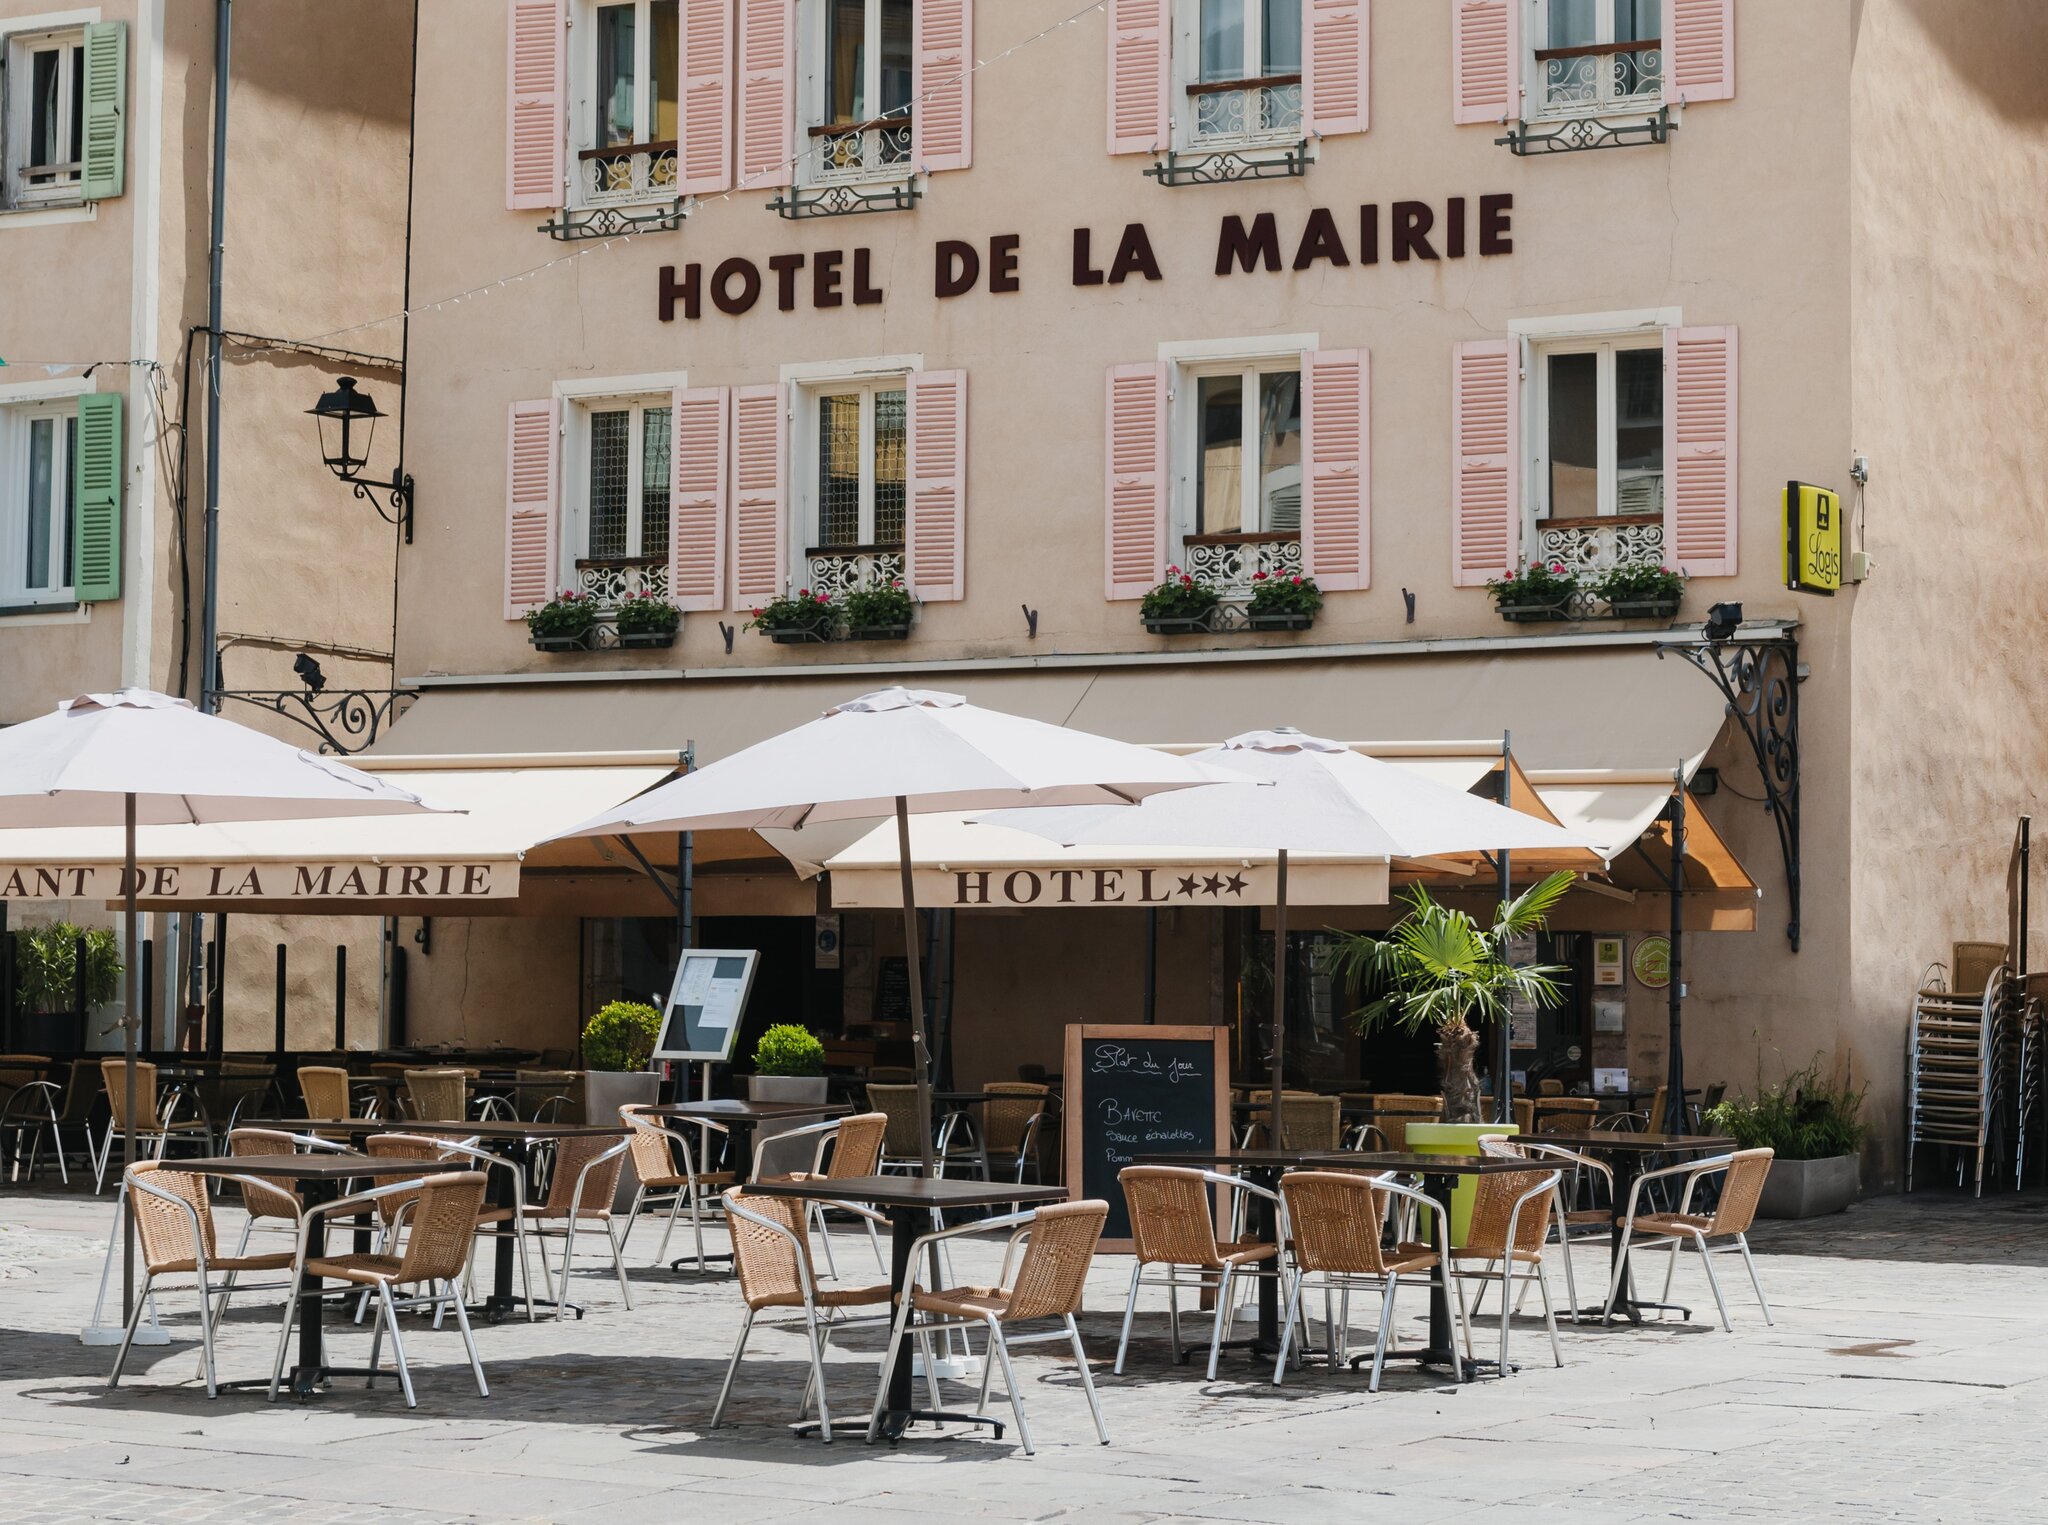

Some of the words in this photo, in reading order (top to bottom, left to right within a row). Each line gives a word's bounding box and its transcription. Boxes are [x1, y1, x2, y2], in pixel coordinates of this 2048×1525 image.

[659, 247, 883, 321] HOTEL
[935, 234, 1020, 298] DE
[1072, 223, 1163, 286] LA
[1214, 193, 1513, 276] MAIRIE
[1807, 532, 1839, 584] Logis
[0, 867, 95, 897] ANT
[116, 866, 180, 897] DE
[206, 866, 265, 896] LA
[291, 864, 492, 896] MAIRIE
[953, 868, 1171, 904] HOTEL
[1094, 1044, 1138, 1068] Plat
[1142, 1051, 1160, 1069] du
[1105, 1147, 1133, 1163] Pomm
